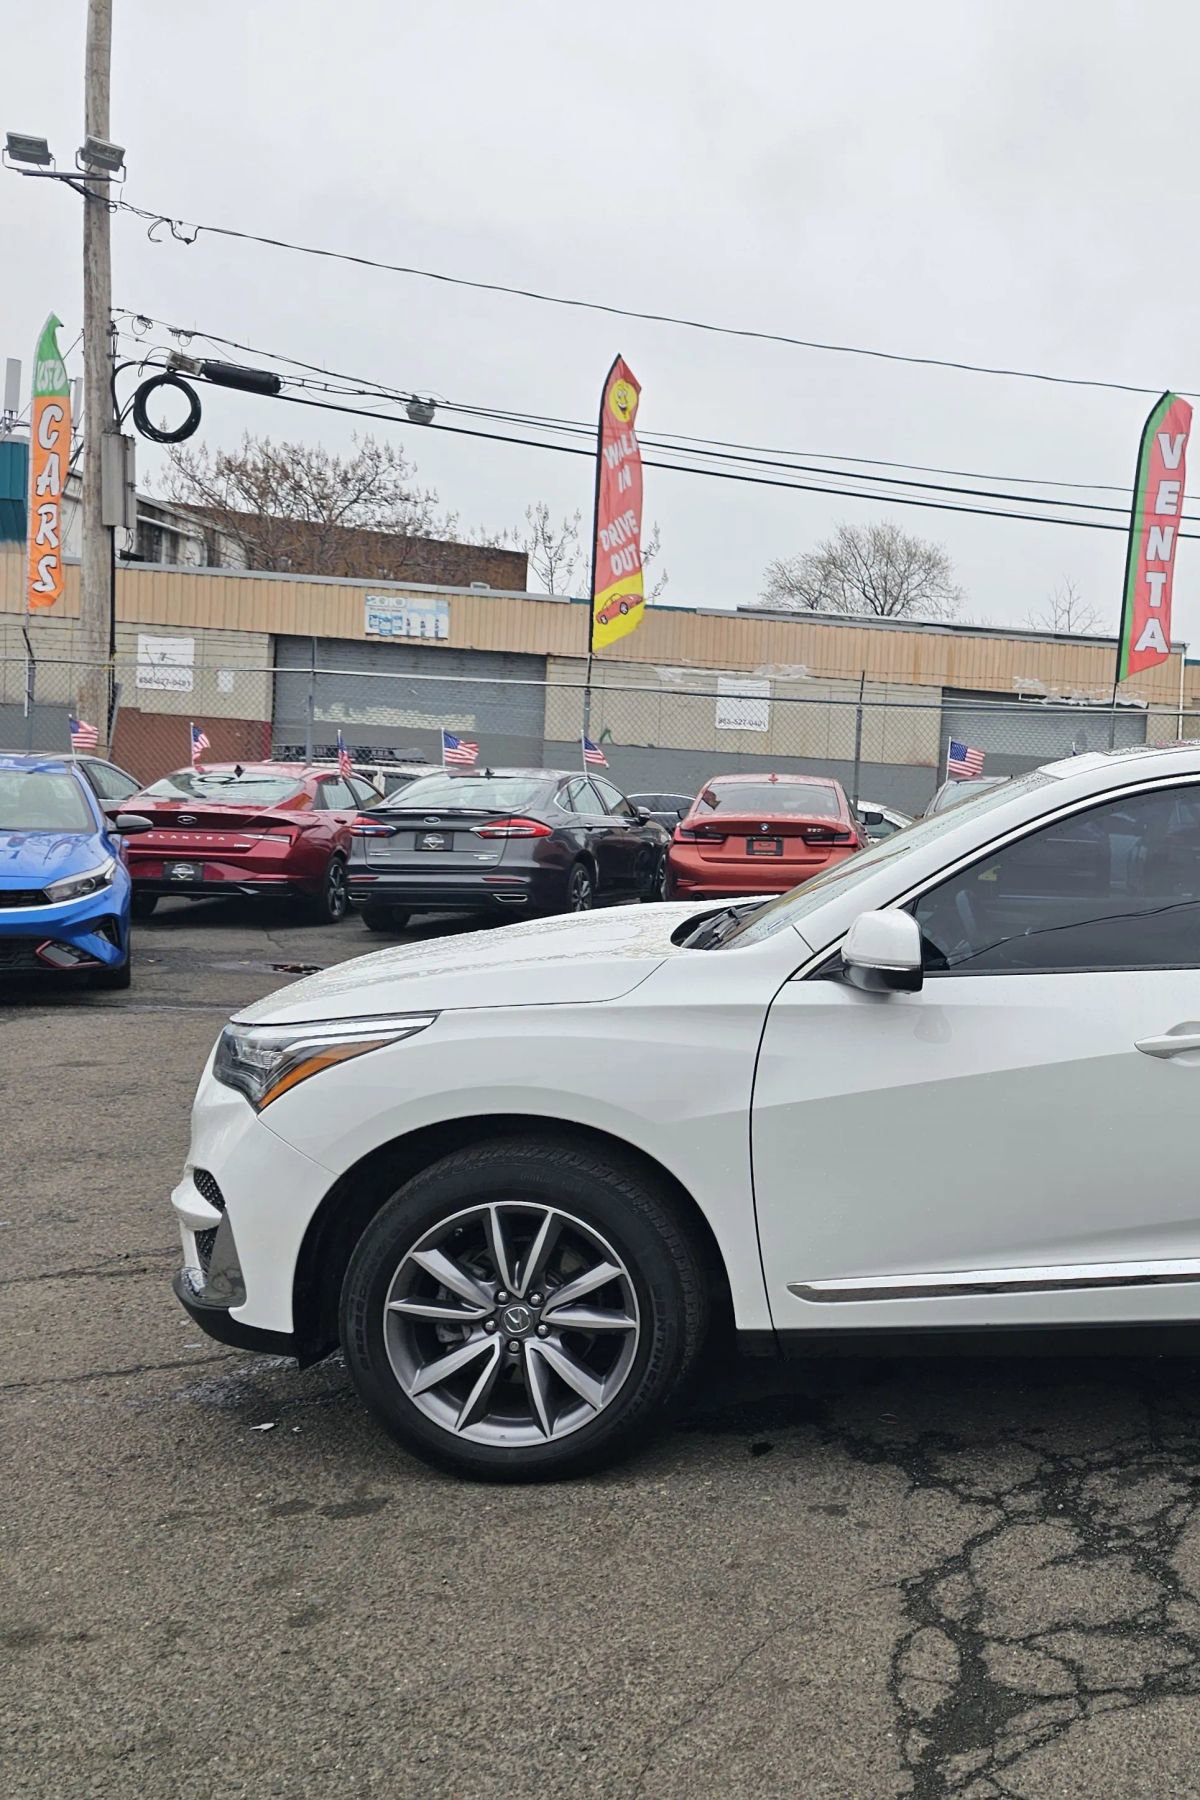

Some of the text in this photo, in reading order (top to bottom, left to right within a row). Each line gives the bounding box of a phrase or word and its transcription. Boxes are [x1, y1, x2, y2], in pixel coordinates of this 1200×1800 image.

[32, 403, 65, 594] CARS
[618, 464, 632, 493] IN
[600, 510, 640, 552] DRIVE
[1134, 432, 1187, 655] VENTA
[610, 543, 639, 576] OUT
